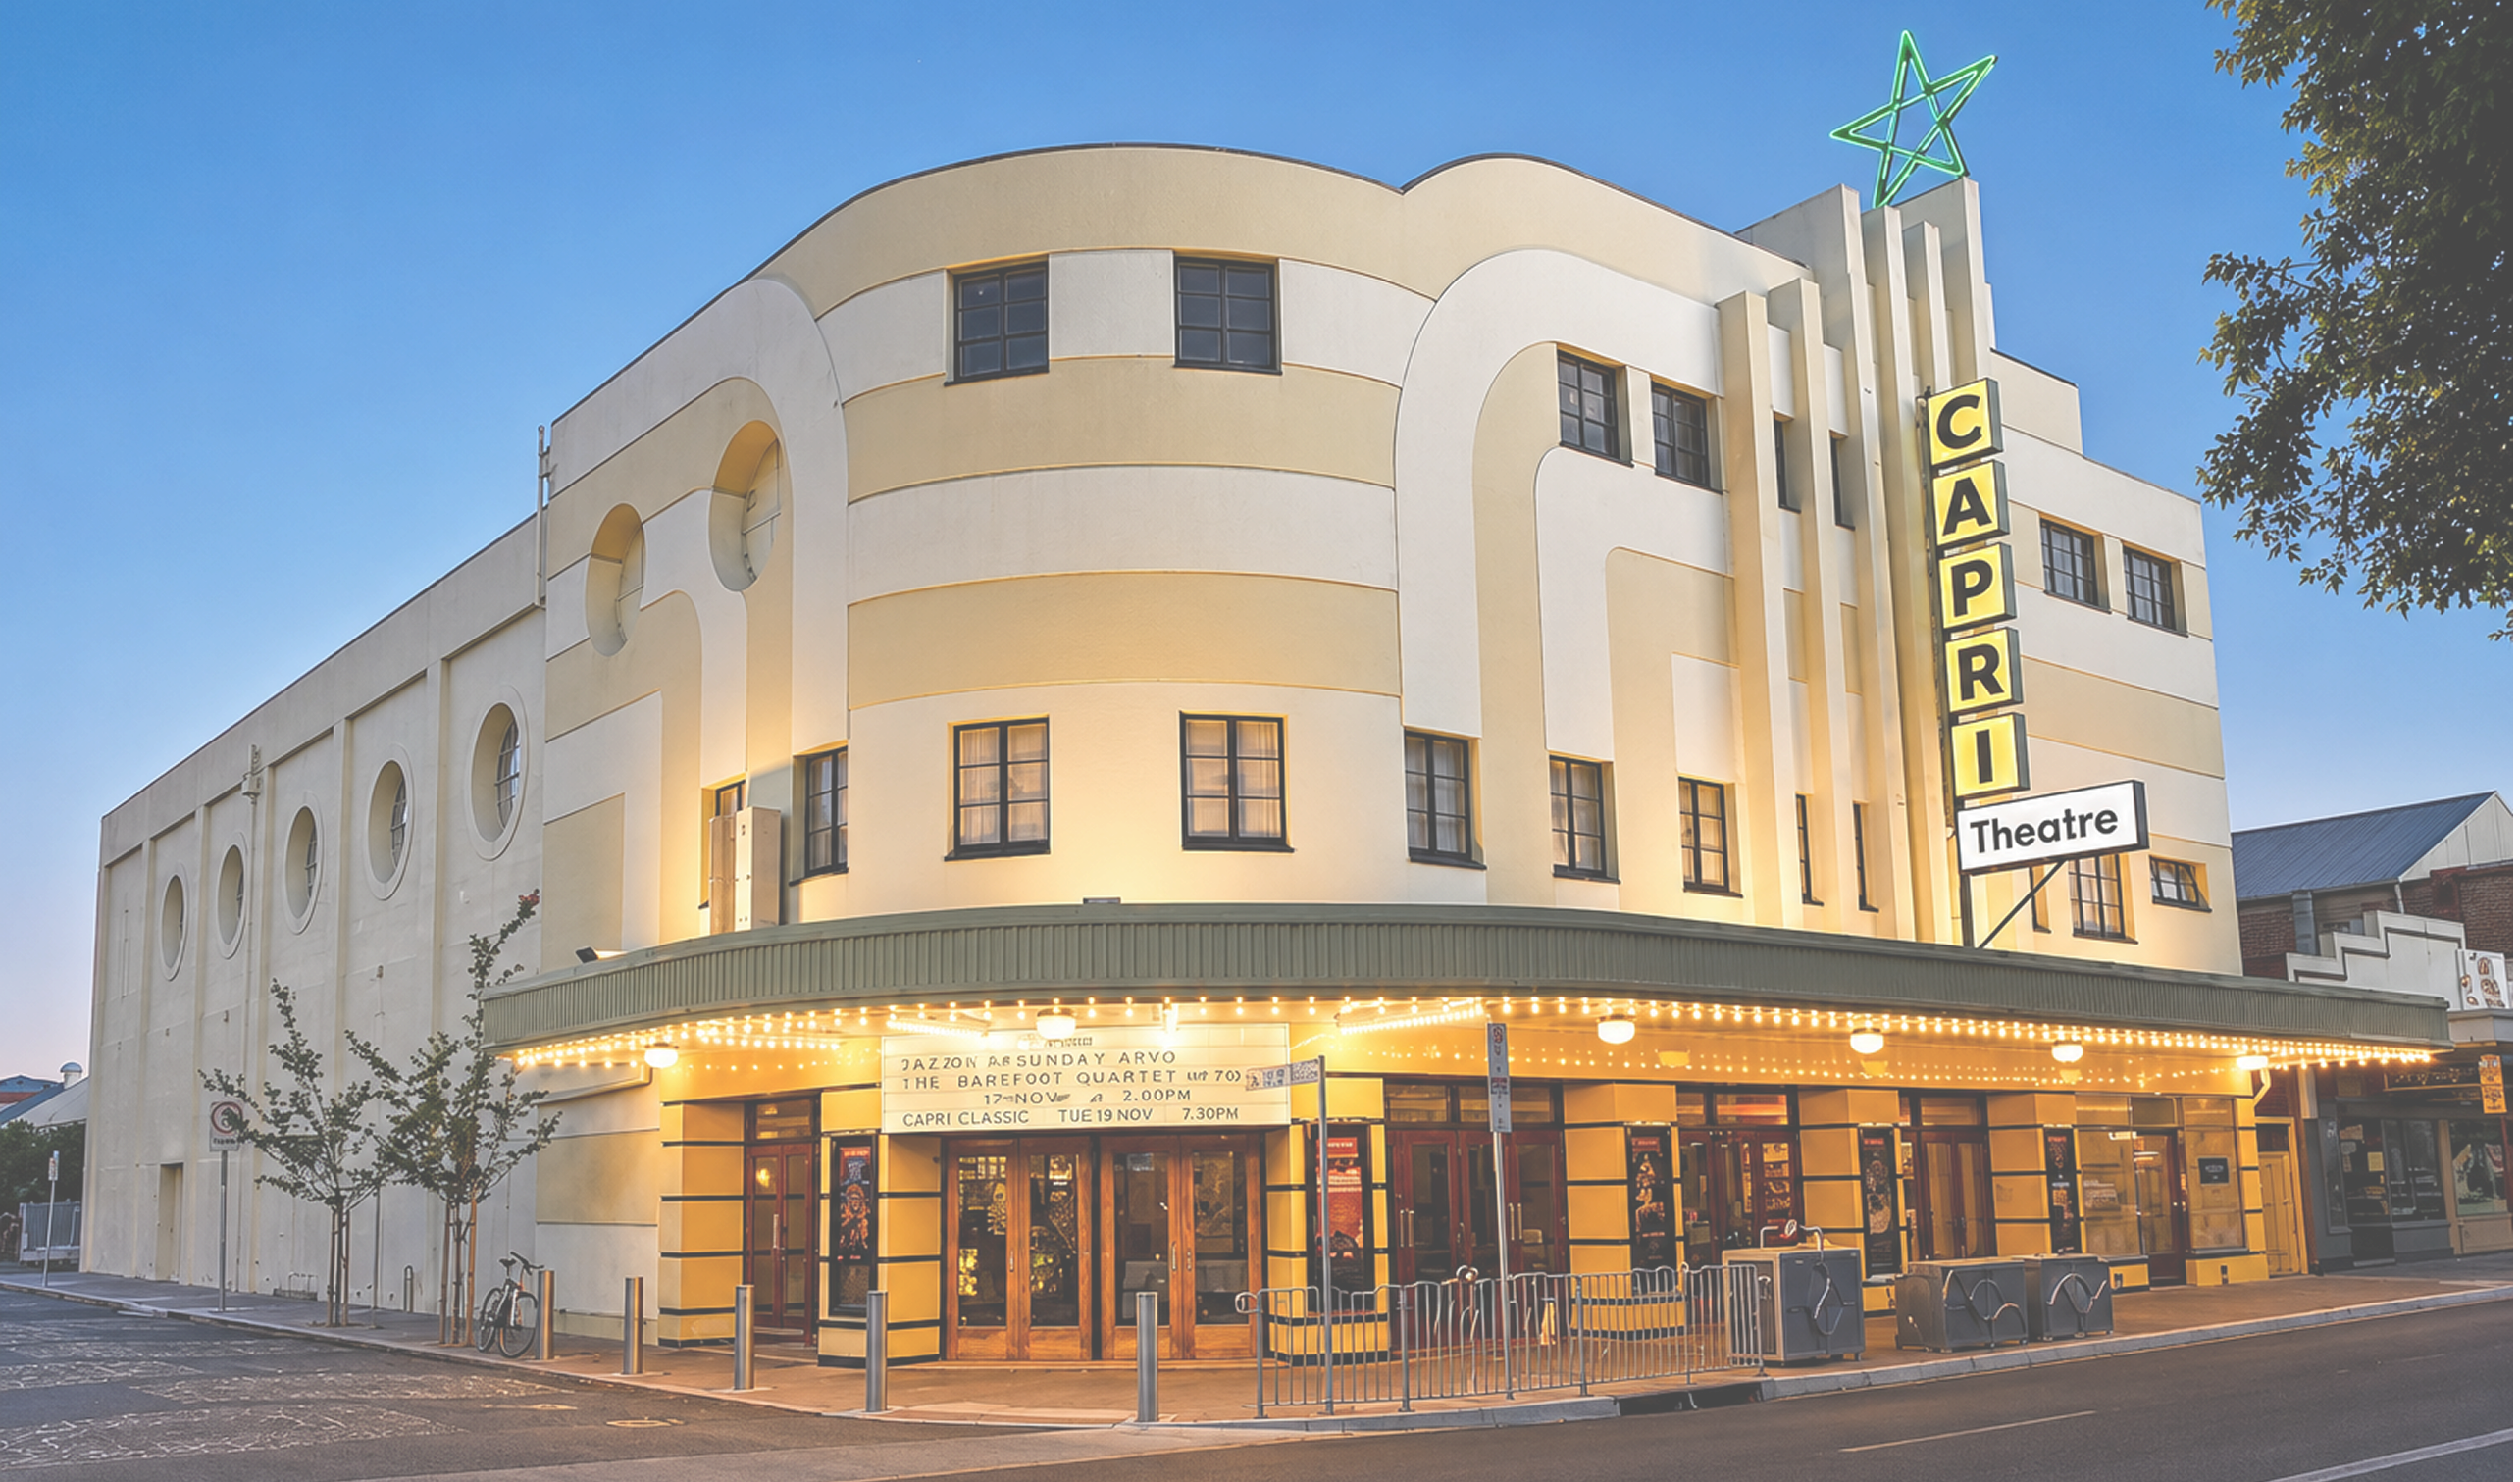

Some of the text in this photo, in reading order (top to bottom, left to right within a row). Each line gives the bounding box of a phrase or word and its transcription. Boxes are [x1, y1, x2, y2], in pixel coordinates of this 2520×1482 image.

[1935, 394, 2004, 784] CAPRI
[1971, 807, 2119, 854] Theatre
[1016, 1052, 1106, 1068] SUNDAY
[1118, 1050, 1176, 1065] ARVO
[902, 1075, 940, 1090] THE
[957, 1071, 1063, 1089] BAREFOOT
[1075, 1069, 1177, 1086] QUARTET
[1122, 1089, 1191, 1102] 2.00PM
[901, 1106, 1239, 1127] CAPRI CLASSIC TUE 19 NOV 7.30PM
